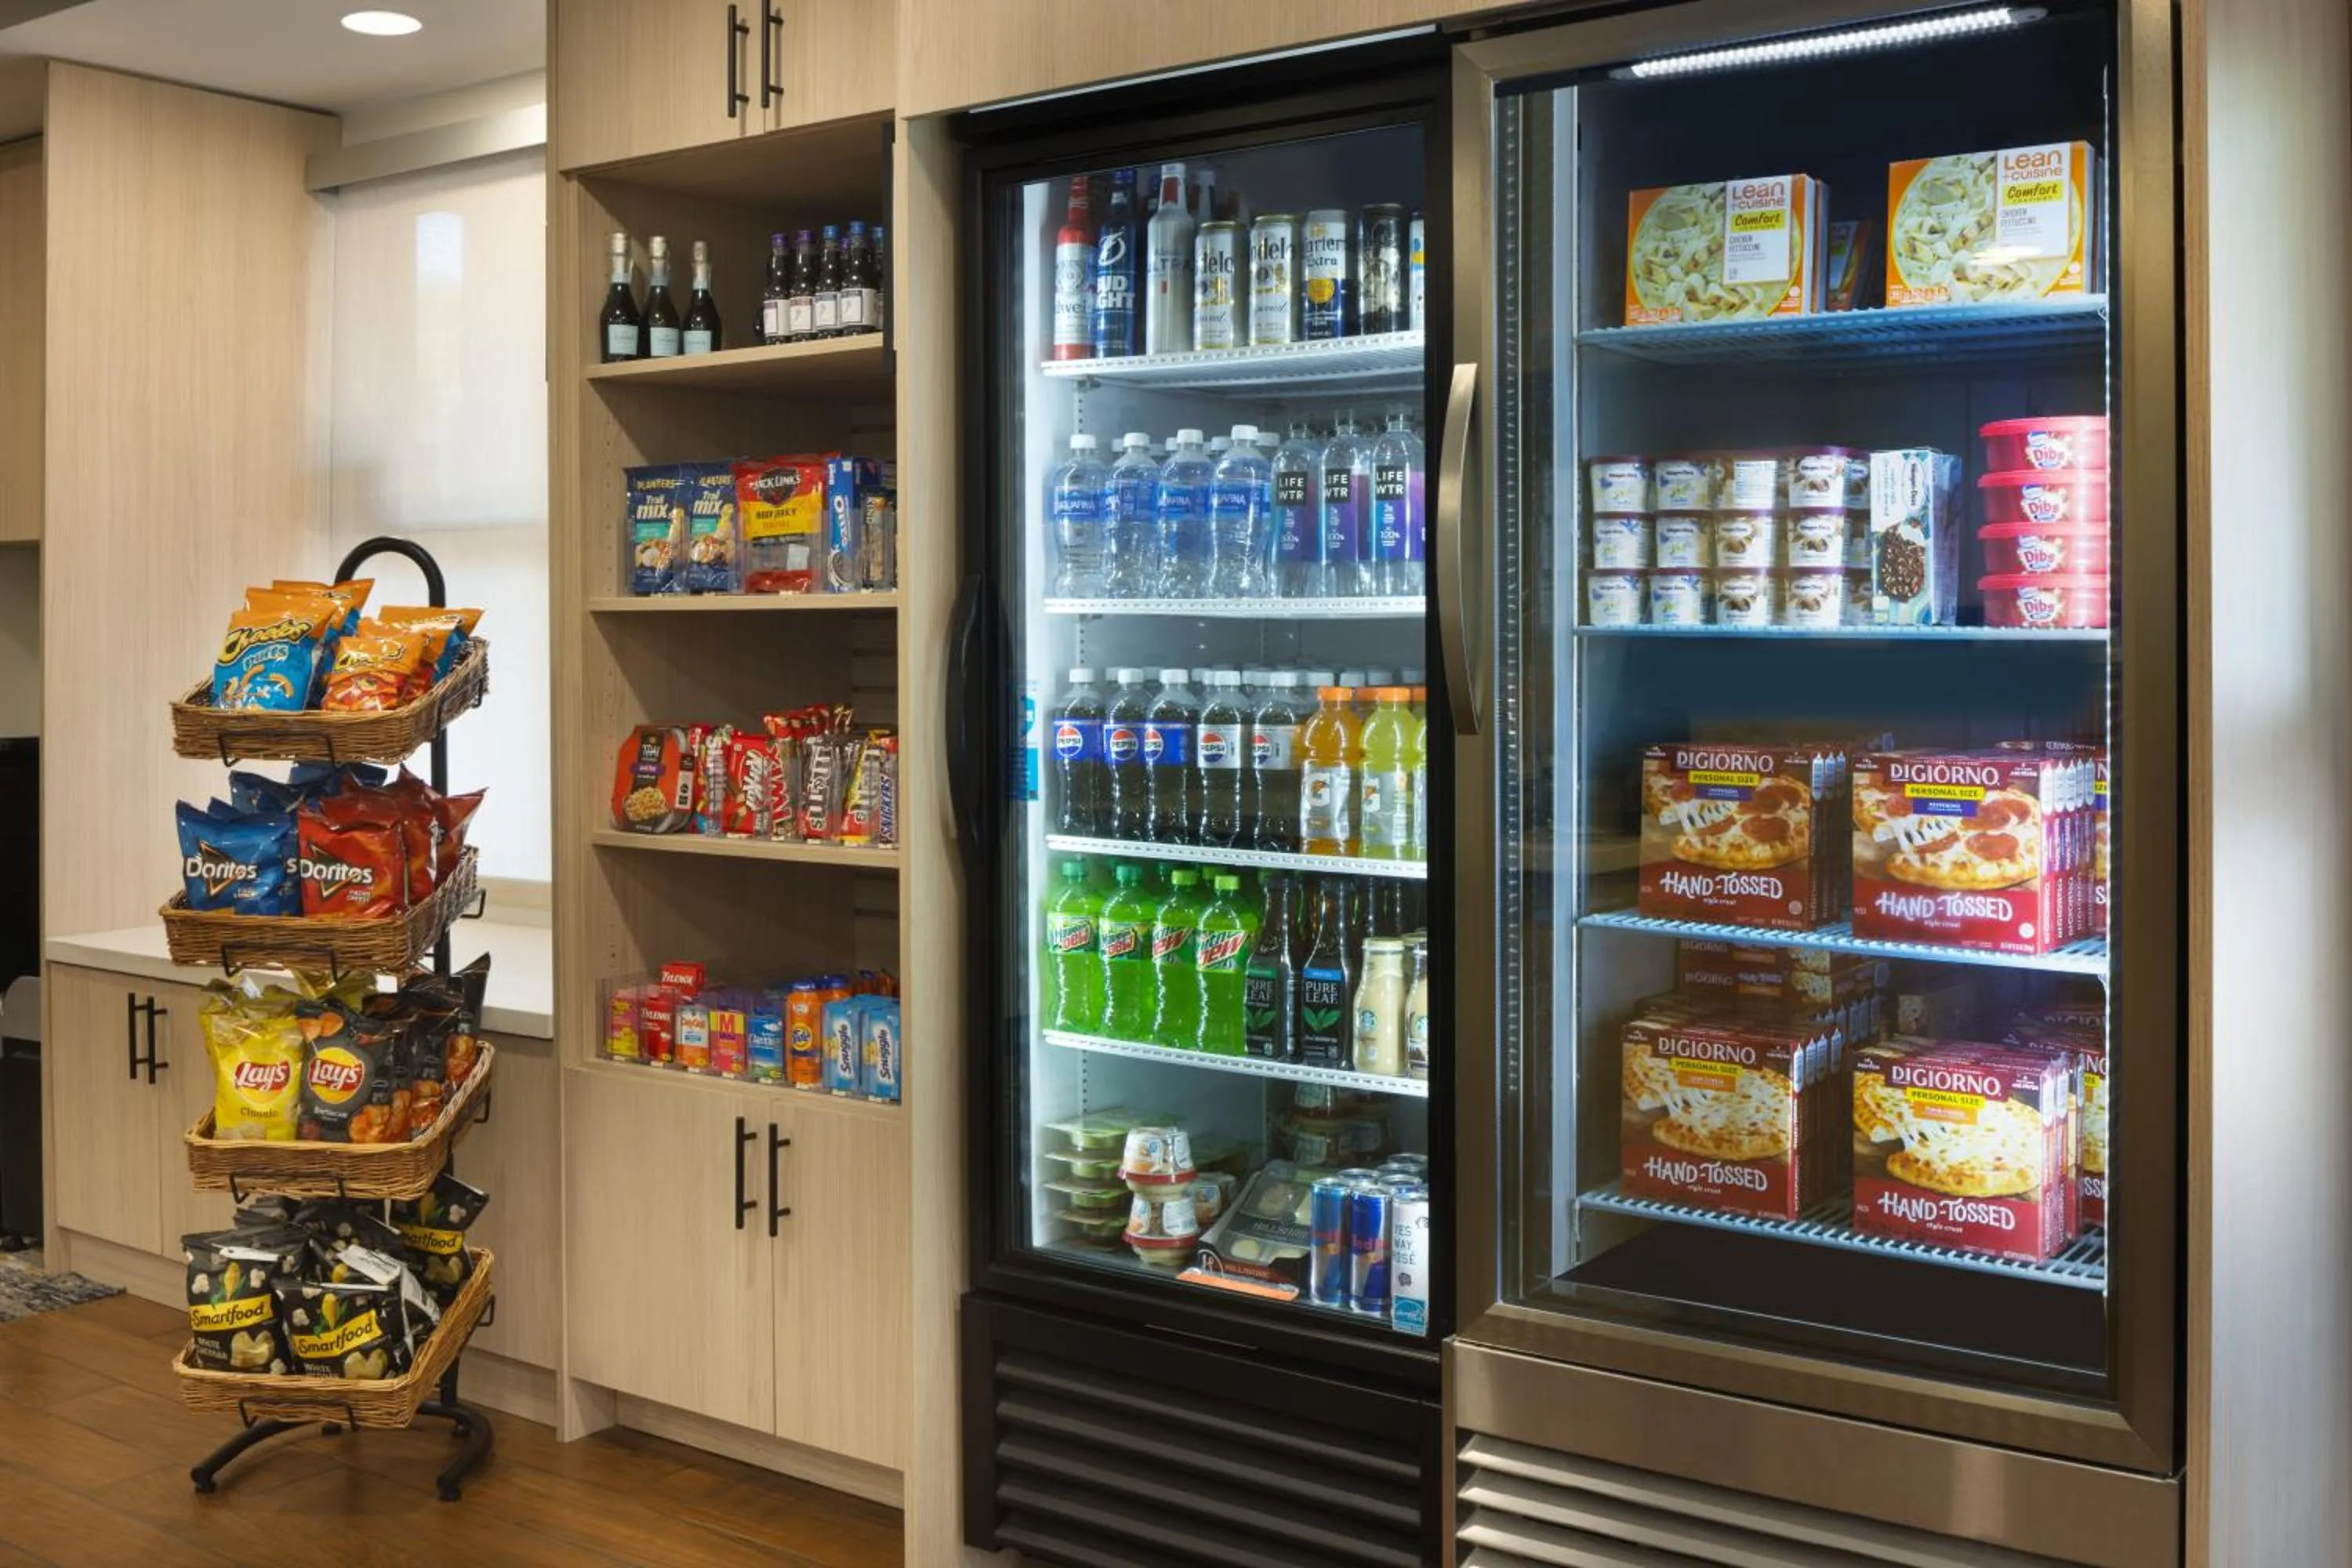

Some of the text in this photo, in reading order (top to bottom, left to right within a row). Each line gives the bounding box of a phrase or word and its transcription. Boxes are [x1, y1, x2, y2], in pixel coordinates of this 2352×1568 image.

[2004, 150, 2062, 170] Lean
[1732, 181, 1784, 200] Lean
[2007, 183, 2058, 200] Comfort
[1735, 212, 1781, 227] Comfort
[1098, 292, 1135, 309] GHT
[2034, 446, 2065, 461] Dibs
[1376, 471, 1404, 483] LIFE
[1376, 484, 1404, 496] WTR
[2028, 499, 2060, 514] Dibs
[2024, 550, 2055, 564] Dibs
[2024, 600, 2055, 615] Dibs
[218, 619, 313, 664] Cheetos
[1677, 752, 1773, 772] DIGIORNO
[1693, 773, 1735, 783] PERSONAL
[1890, 763, 1999, 785] DIGIORNO
[1910, 786, 1979, 798] PERSONAL SIZE
[879, 775, 893, 840] SNICKERS
[186, 858, 258, 880] Doritos
[299, 858, 374, 884] Doritos
[1660, 871, 1784, 900] HAND-TOSSED
[1875, 891, 2013, 922] HAND-TOSSED
[1305, 981, 1337, 993] PURE
[1305, 993, 1338, 1004] LEAF
[791, 1029, 811, 1044] Tide
[840, 1022, 852, 1073] Snuggle
[880, 1029, 891, 1080] Snuggle
[1658, 1038, 1756, 1065] DIGIORNO
[236, 1062, 288, 1092] Lay's
[311, 1059, 361, 1091] Lay's
[1676, 1061, 1719, 1073] PERSONAL
[1892, 1065, 2001, 1097] DIGIORNO
[1911, 1091, 1980, 1106] PERSONAL SIZE
[1644, 1156, 1767, 1192] HAND-TOSSED
[1878, 1192, 2016, 1230] HAND-TOSSED
[403, 1229, 457, 1250] artfood
[191, 1301, 265, 1327] Smartfood
[297, 1320, 373, 1352] Smartfood
